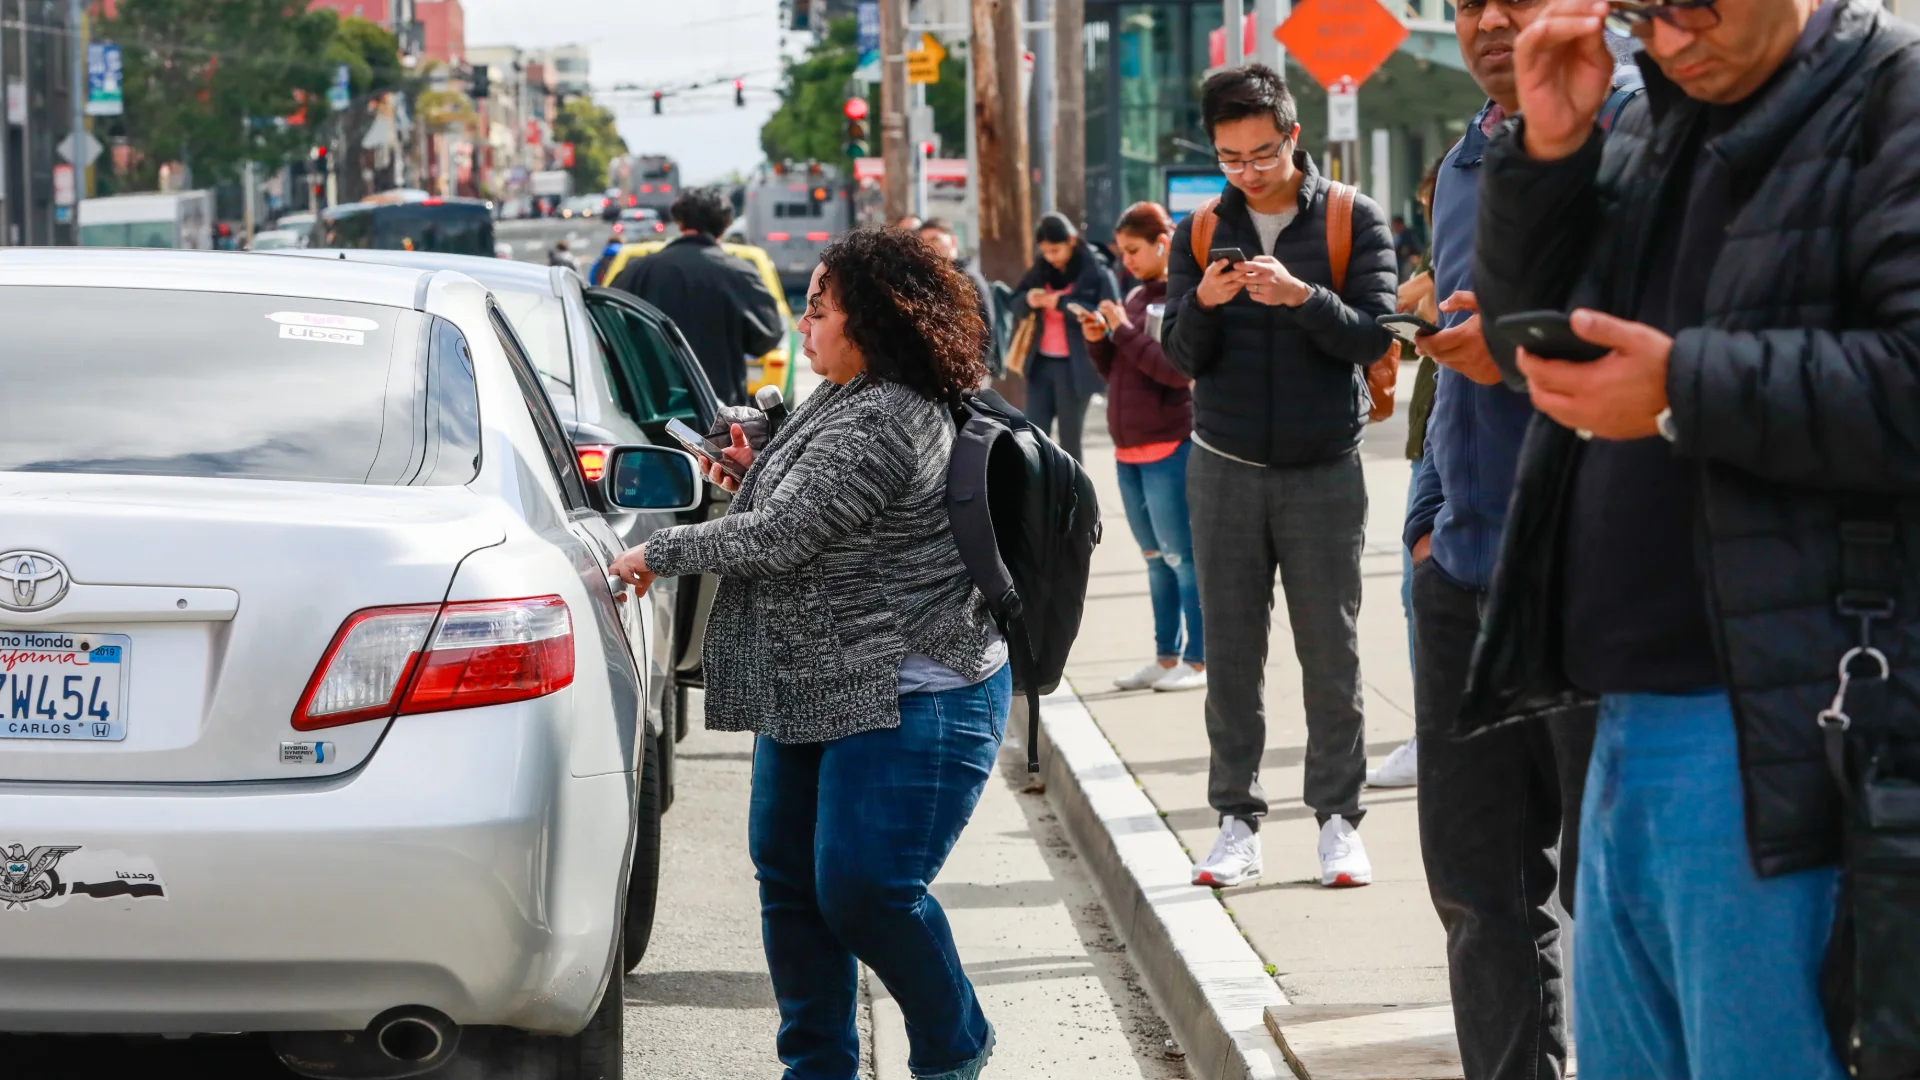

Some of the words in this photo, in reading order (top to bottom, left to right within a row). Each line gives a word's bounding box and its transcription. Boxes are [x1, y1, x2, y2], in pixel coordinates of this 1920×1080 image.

[288, 327, 355, 341] Uber
[25, 634, 73, 648] Honda
[95, 647, 115, 656] 2019
[0, 649, 89, 671] ifornia
[9, 722, 71, 734] CARLOS
[115, 870, 155, 882] وحدتنا
